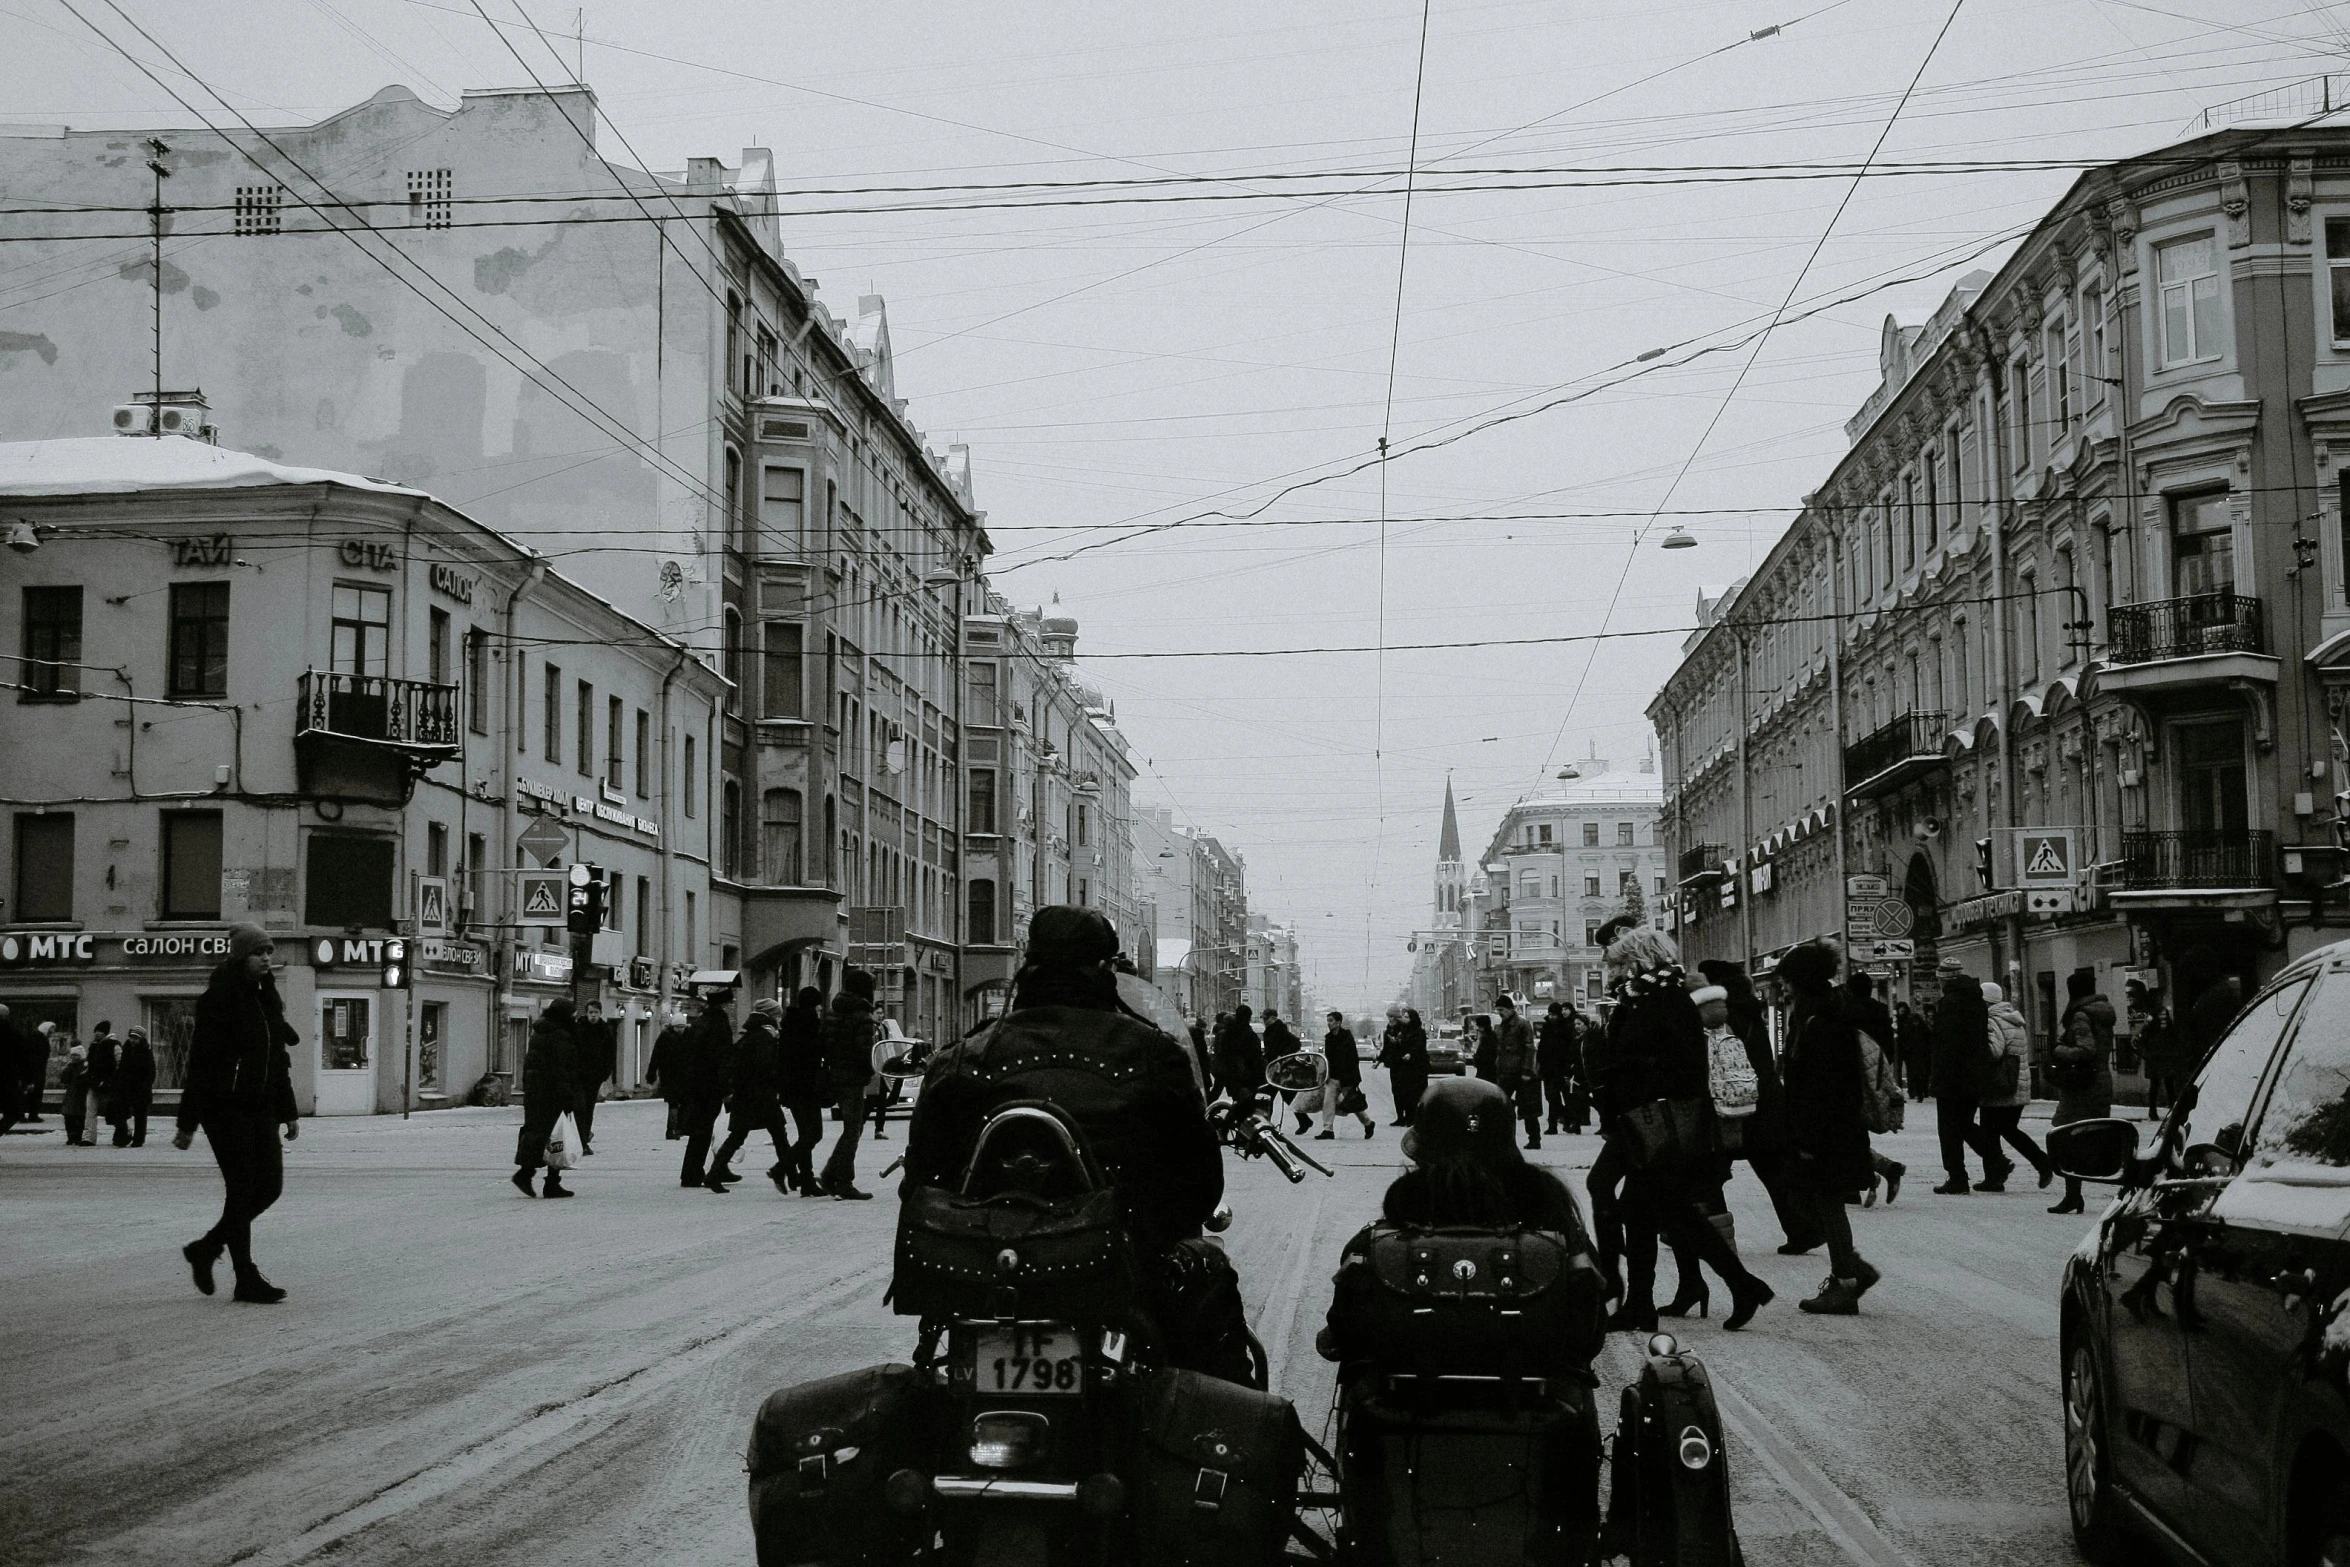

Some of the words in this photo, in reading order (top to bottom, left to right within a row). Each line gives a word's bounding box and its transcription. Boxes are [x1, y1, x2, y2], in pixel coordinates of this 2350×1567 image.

[340, 539, 400, 570] СПА
[432, 564, 472, 605] САЛОН
[576, 796, 594, 814] ЦЕНТР
[30, 935, 93, 959] МТС
[123, 938, 195, 955] салон
[200, 938, 230, 955] св
[954, 1367, 974, 1381] LV
[994, 1358, 1075, 1390] 1798
